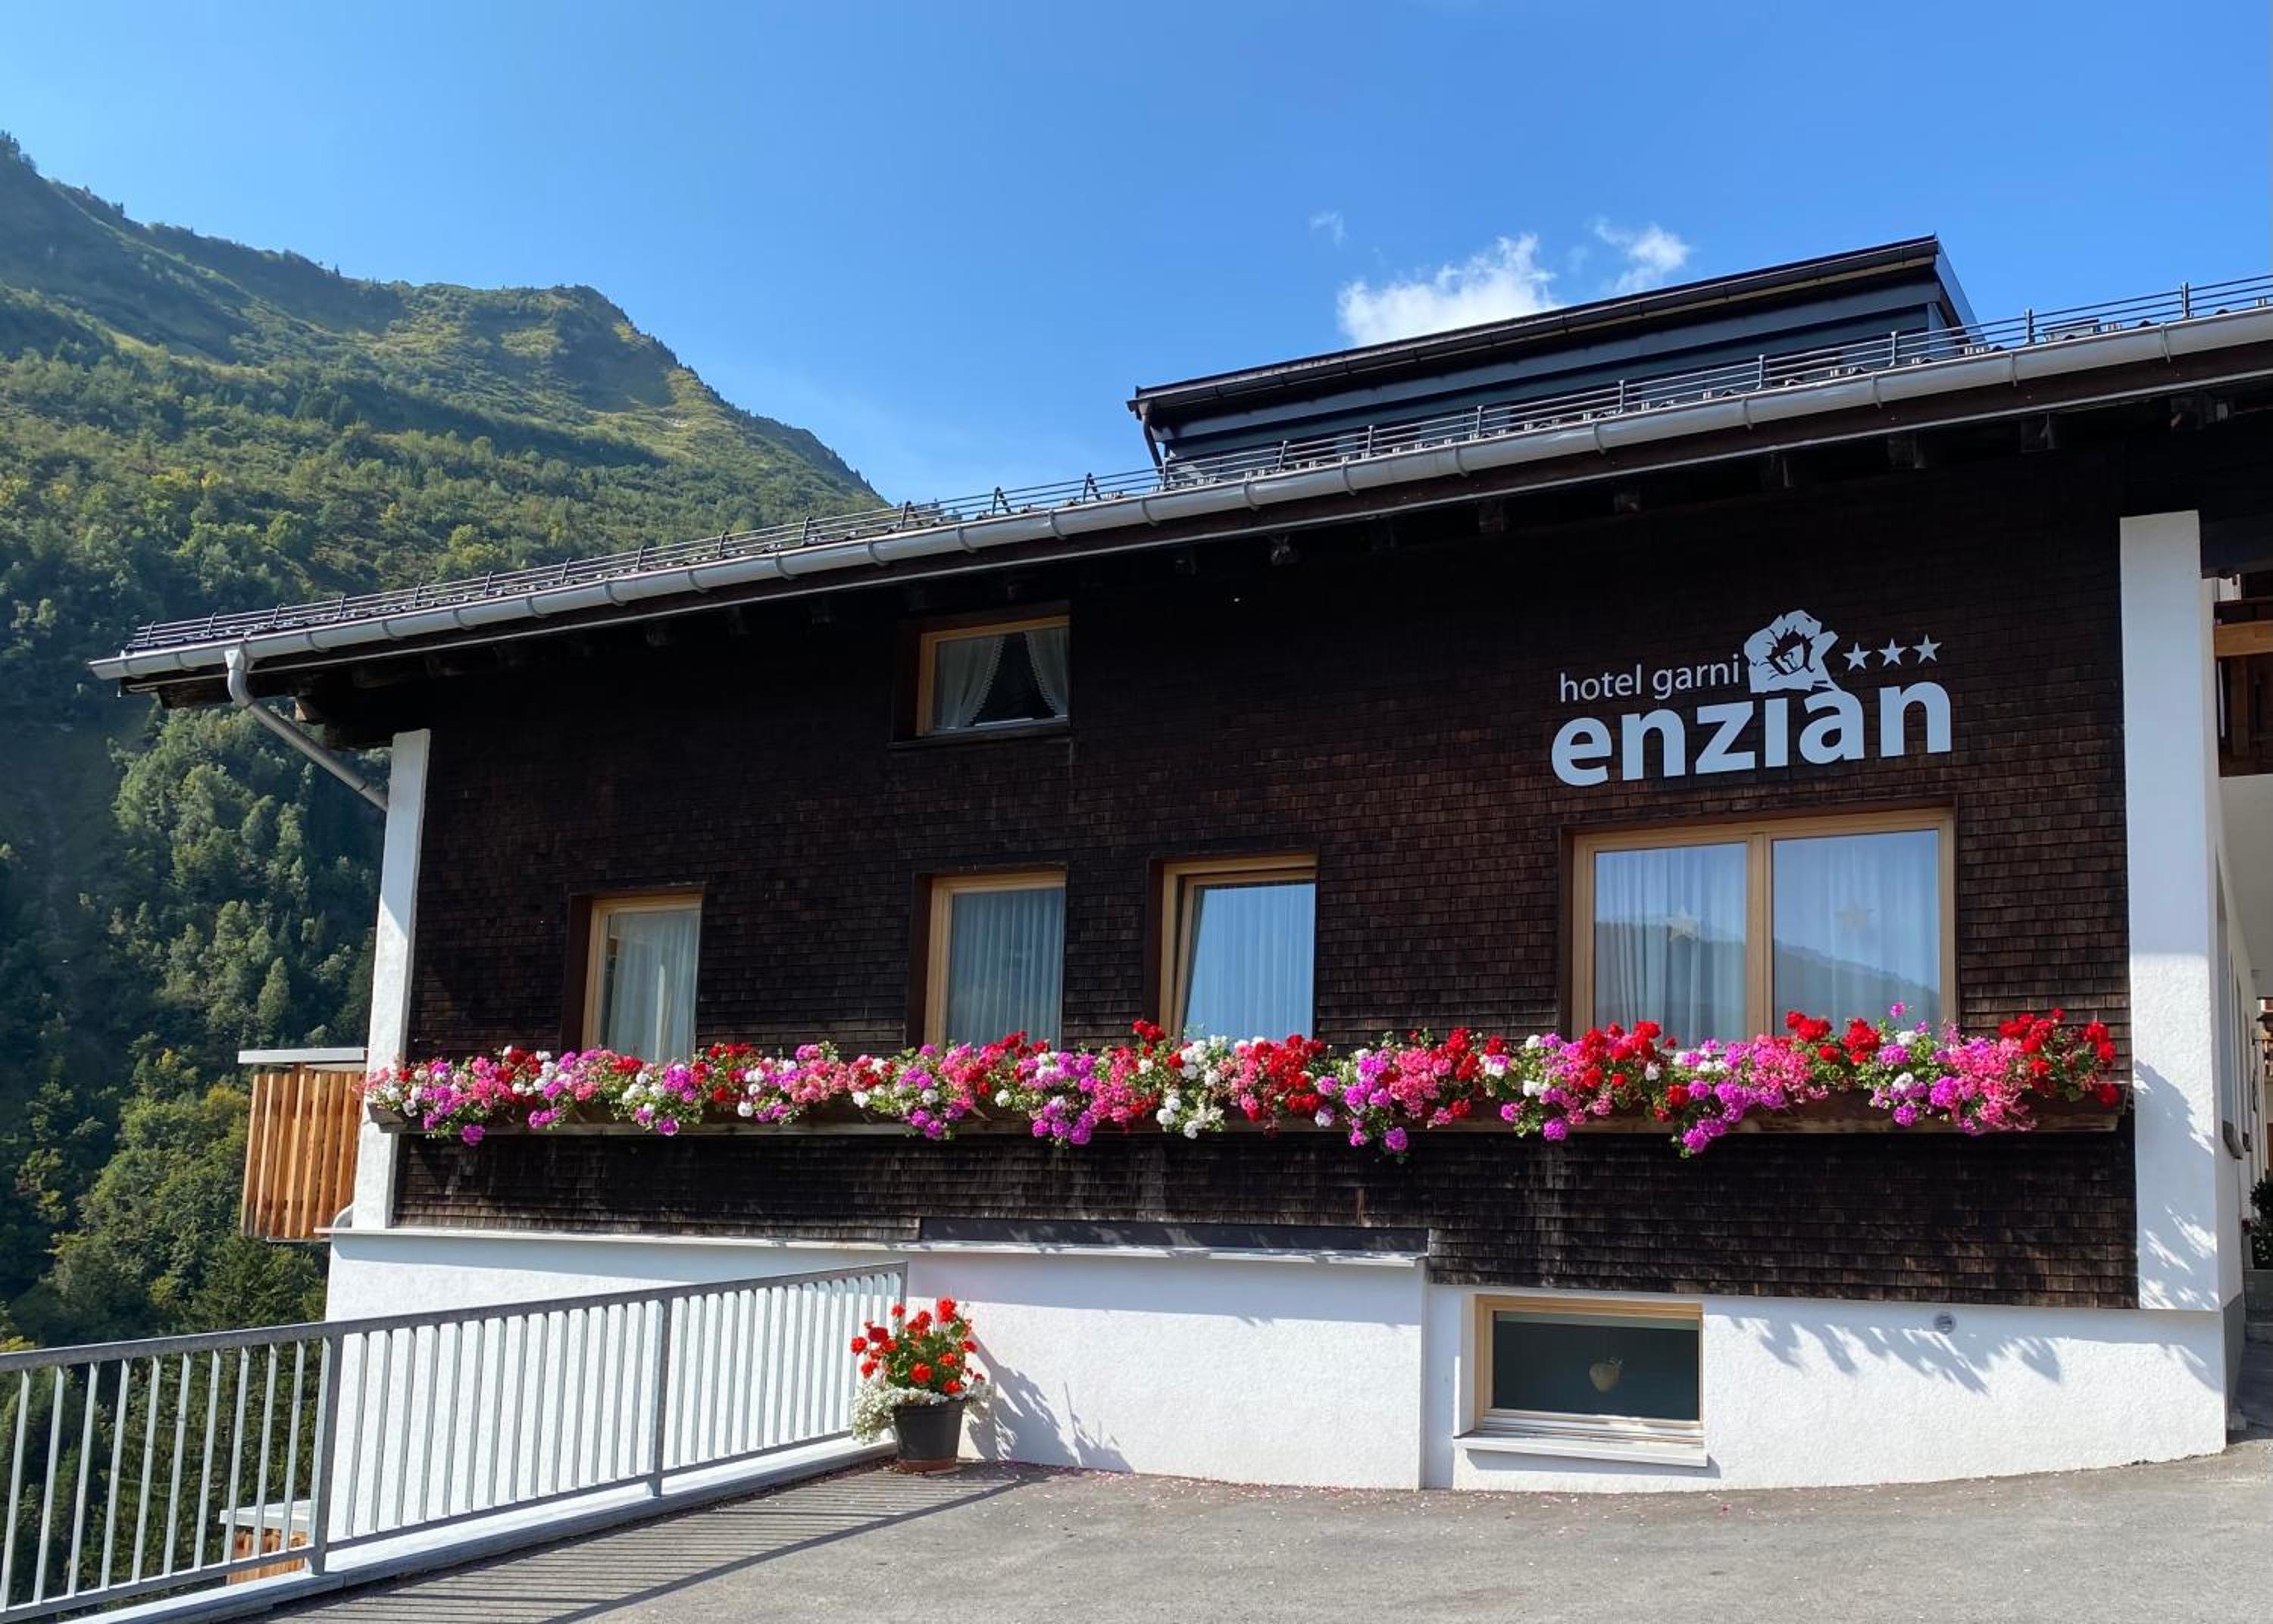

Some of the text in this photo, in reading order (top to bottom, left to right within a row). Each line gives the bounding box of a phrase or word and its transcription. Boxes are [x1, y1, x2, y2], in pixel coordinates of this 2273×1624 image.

[1559, 654, 1739, 703] hotel garni
[1551, 681, 1953, 786] enzian
